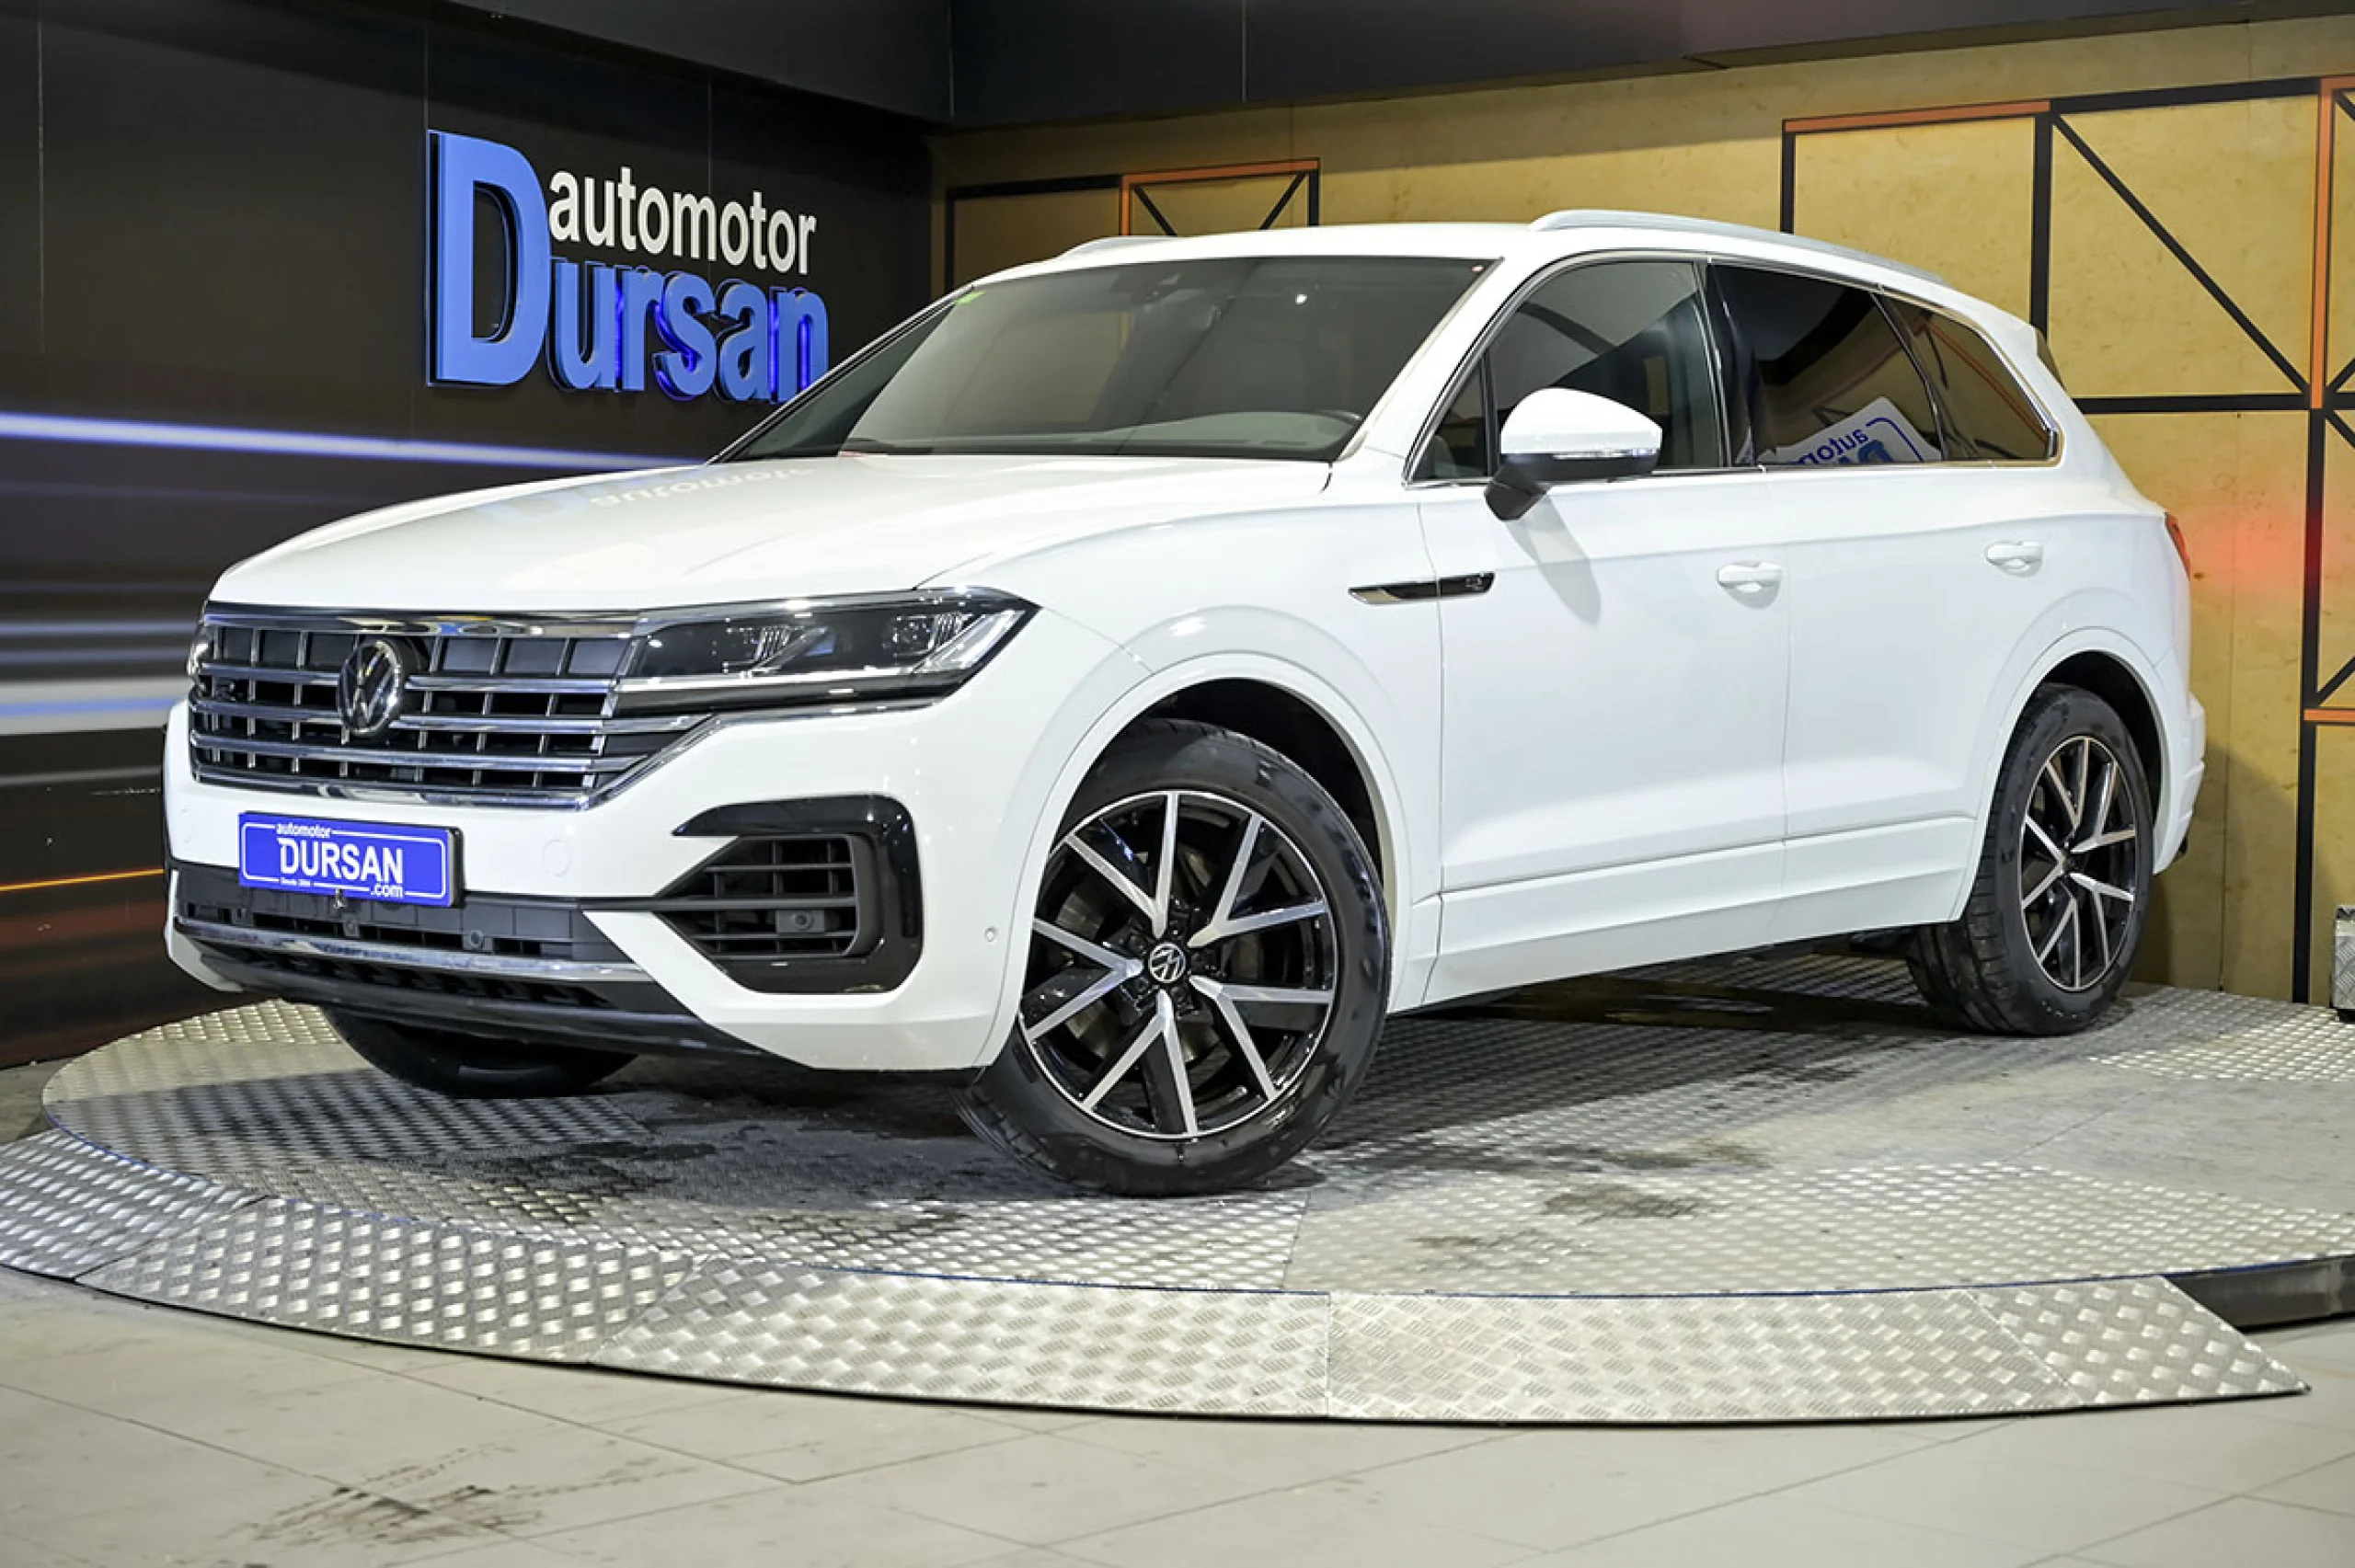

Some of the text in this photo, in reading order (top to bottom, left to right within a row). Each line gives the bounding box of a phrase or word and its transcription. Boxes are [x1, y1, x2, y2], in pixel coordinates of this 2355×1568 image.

[549, 166, 817, 275] automotor
[427, 129, 829, 406] Dursan
[276, 821, 331, 839] automotor
[277, 837, 403, 884] DURSAN
[370, 883, 403, 898] .com
